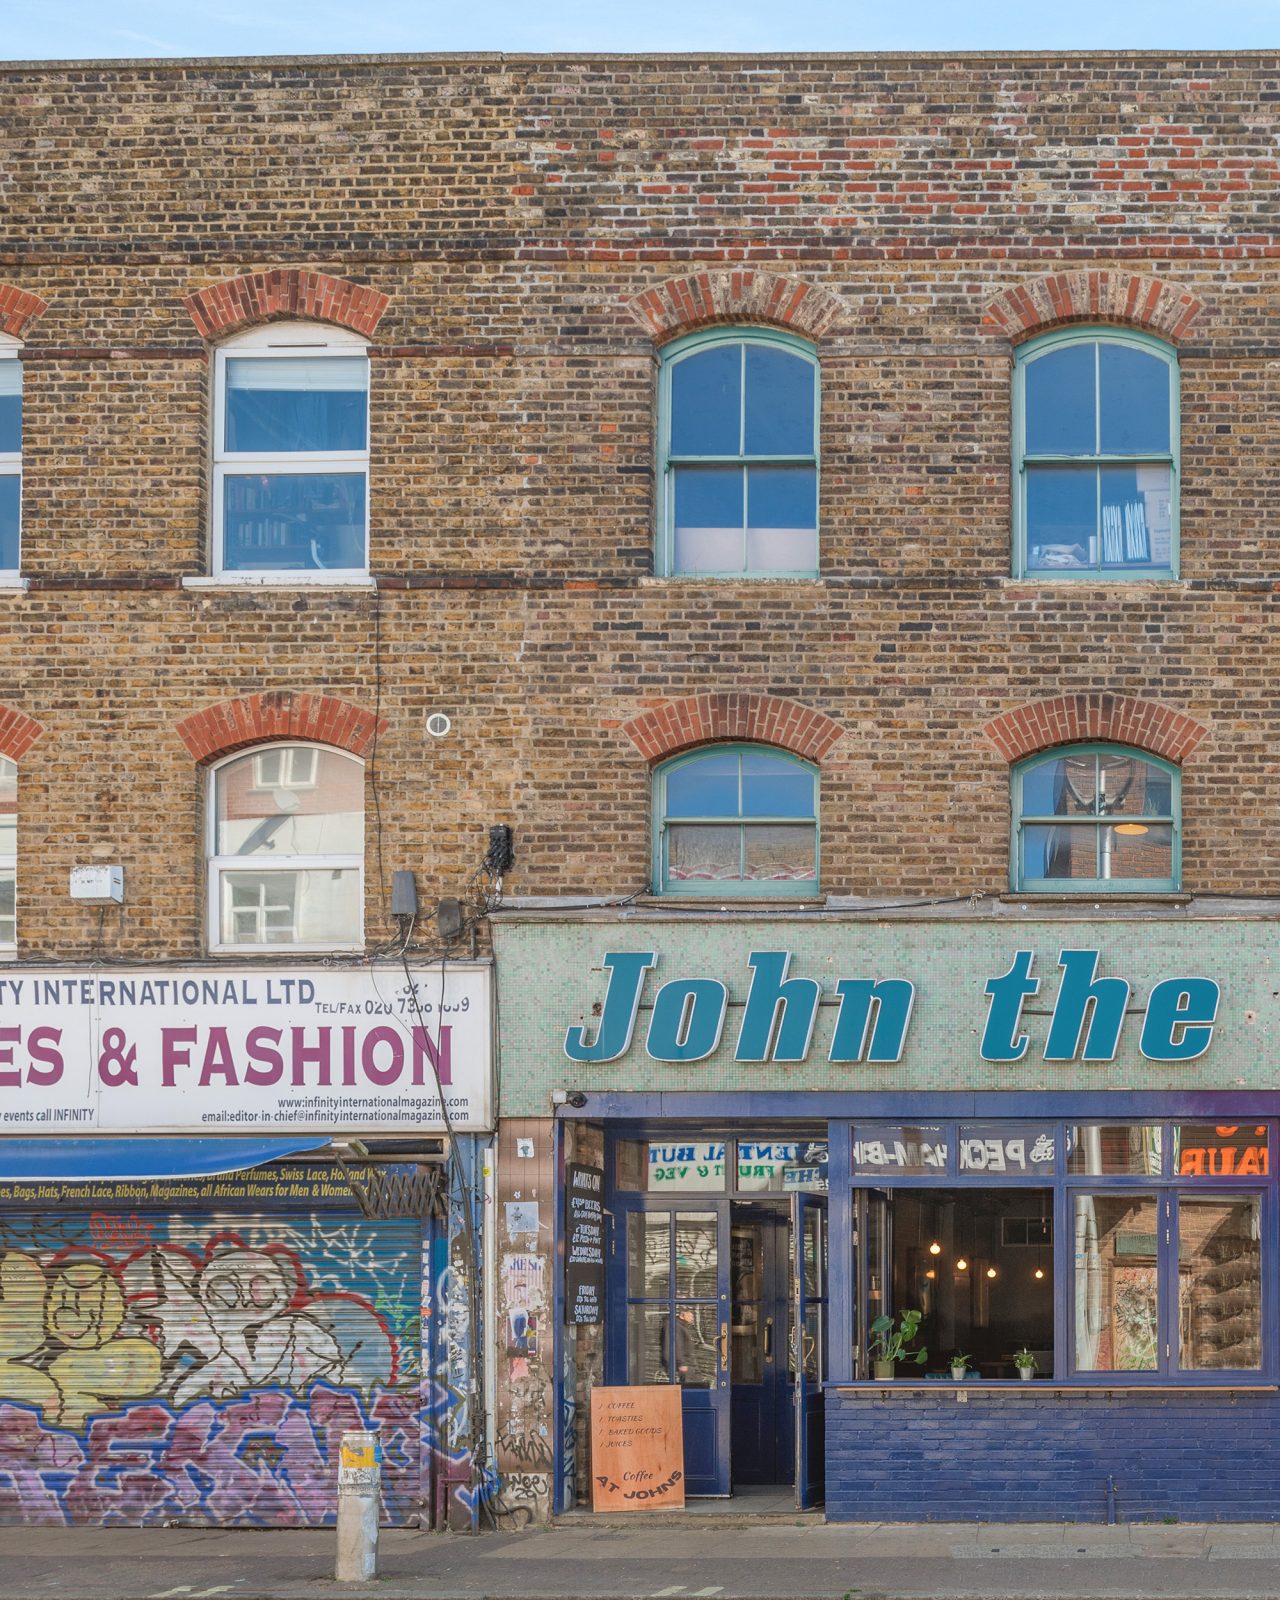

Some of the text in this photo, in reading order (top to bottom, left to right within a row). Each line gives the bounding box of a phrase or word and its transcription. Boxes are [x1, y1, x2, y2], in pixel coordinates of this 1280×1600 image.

[34, 980, 257, 1005] INTERNATIONAL
[267, 980, 315, 1004] LTD
[563, 950, 917, 1063] John
[979, 949, 1222, 1062] the
[98, 1027, 138, 1087] &
[161, 1024, 453, 1087] FASHION
[4, 1108, 95, 1121] events call INFINITY
[235, 1168, 278, 1184] Perfumes,
[280, 1168, 303, 1181] Swiss
[306, 1168, 330, 1182] Lace,
[330, 1168, 366, 1181] Hoand
[13, 1185, 37, 1201] Bags,
[38, 1185, 60, 1199] Hats,
[61, 1185, 90, 1198] French
[92, 1185, 114, 1199] Lace,
[115, 1185, 148, 1198] Ribbon,
[150, 1184, 199, 1200] Magazines,
[201, 1184, 212, 1197] all
[214, 1184, 245, 1197] African
[247, 1184, 274, 1197] Wears
[275, 1184, 288, 1197] for
[290, 1184, 309, 1197] Men
[312, 1184, 320, 1197] &
[321, 1184, 354, 1197] Women
[607, 1402, 636, 1410] COFFEE
[608, 1415, 643, 1423] TOASTIES
[635, 1427, 662, 1435] GOODS
[606, 1440, 633, 1448] JUICES
[623, 1470, 654, 1483] Coffee
[595, 1470, 682, 1500] AT JOHNS
